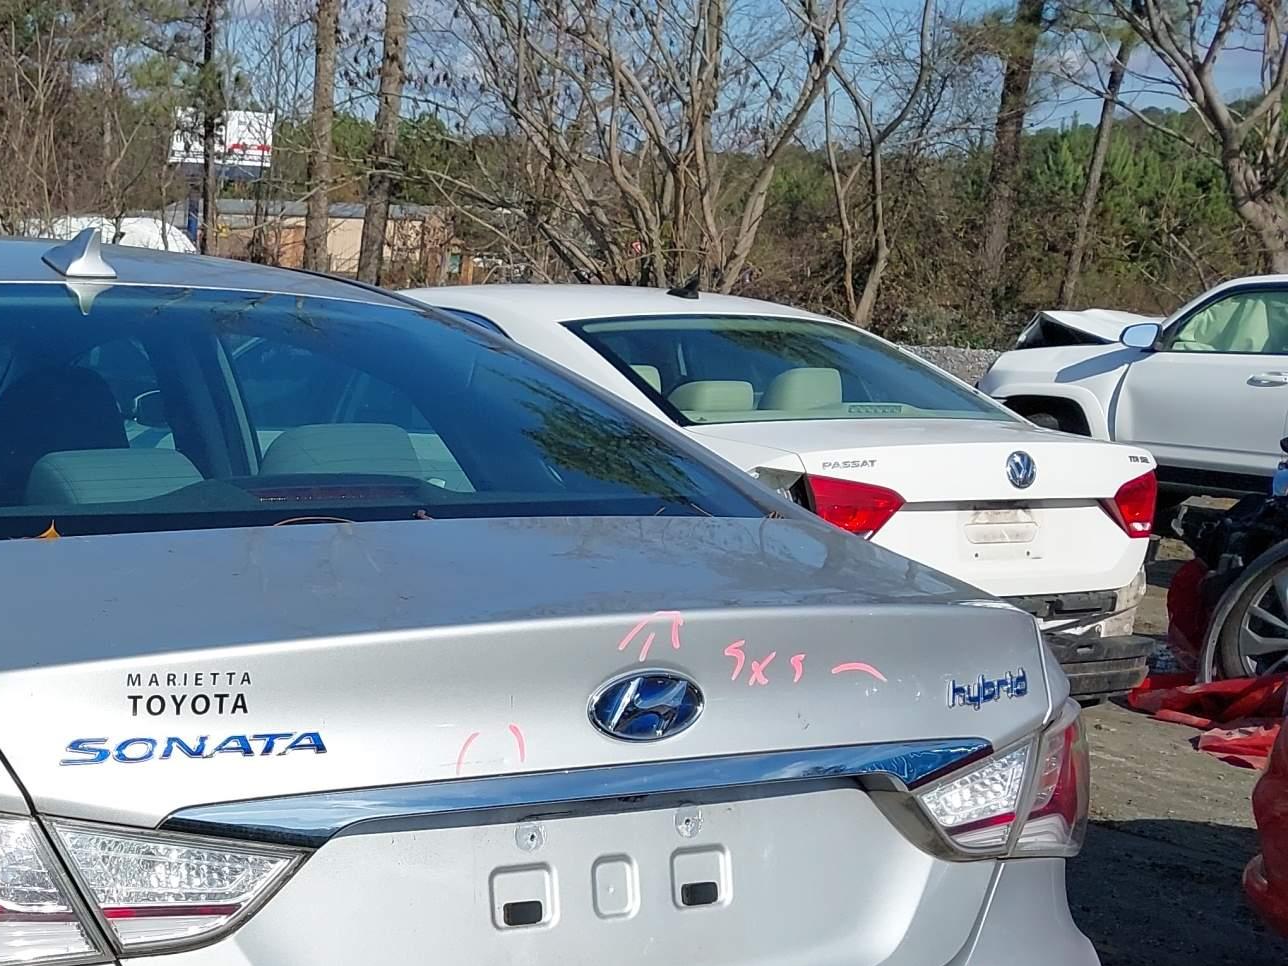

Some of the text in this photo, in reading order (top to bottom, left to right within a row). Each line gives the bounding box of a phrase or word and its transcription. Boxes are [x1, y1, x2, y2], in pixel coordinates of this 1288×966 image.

[822, 459, 878, 470] PASSAT
[126, 671, 252, 687] MARIETTA
[947, 666, 1028, 711] hybrid
[127, 693, 249, 717] TOYOTA
[59, 731, 328, 766] SONATA
